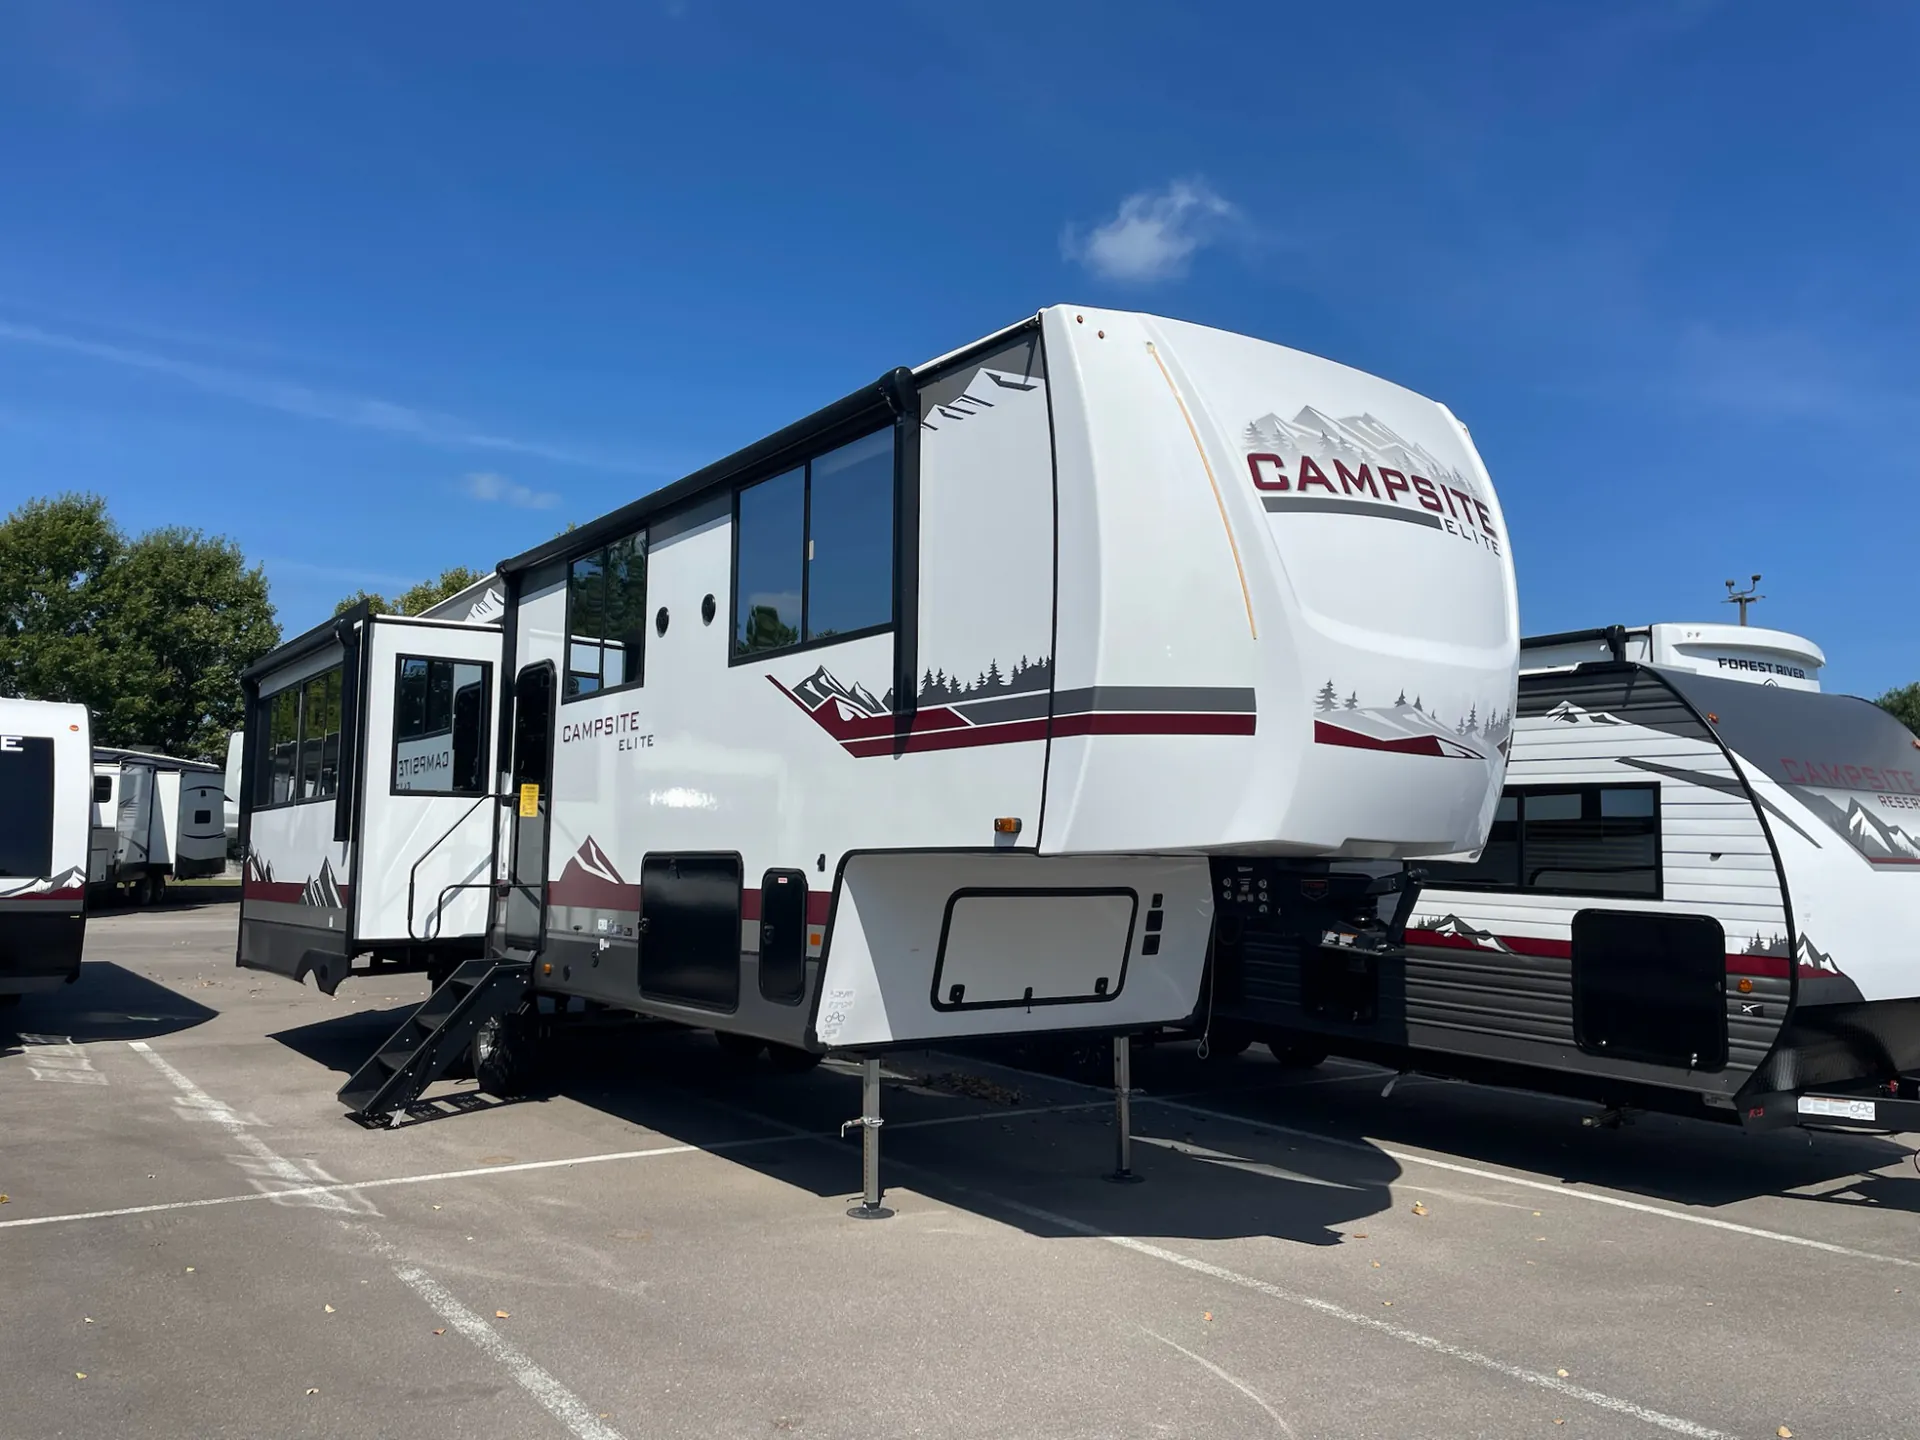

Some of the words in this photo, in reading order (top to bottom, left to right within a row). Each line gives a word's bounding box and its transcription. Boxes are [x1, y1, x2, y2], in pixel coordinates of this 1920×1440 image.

[1247, 452, 1498, 539] CAMPSITE
[1443, 520, 1501, 557] ELITE
[1717, 657, 1773, 673] FOREST
[1775, 664, 1805, 679] RIVER
[562, 711, 640, 743] CAMPSITE
[618, 734, 654, 751] ELITE
[1780, 757, 1920, 793] CAMPSITE
